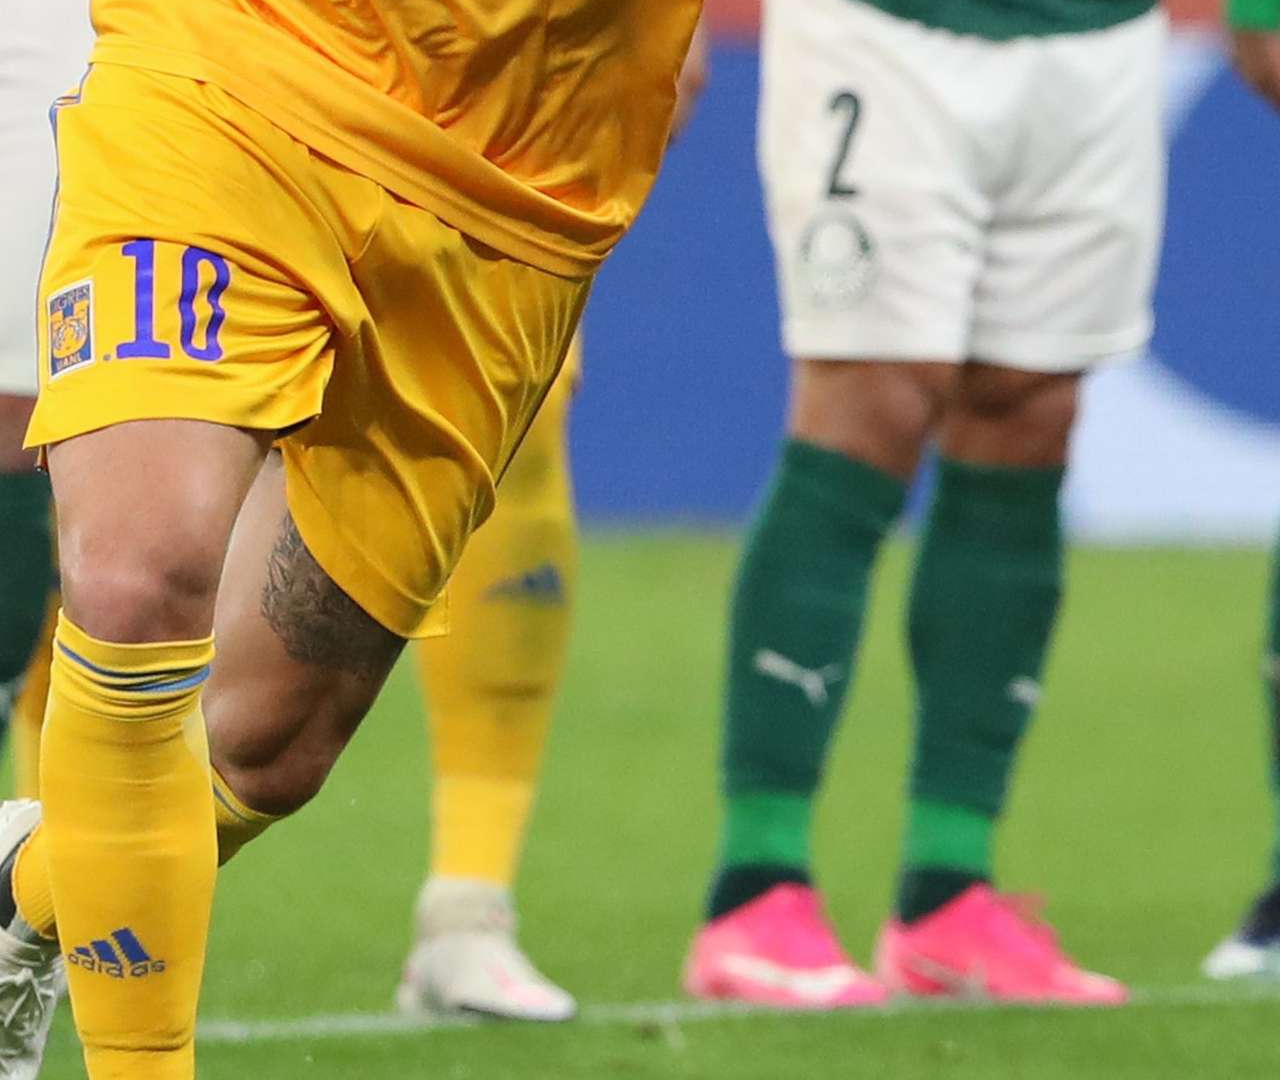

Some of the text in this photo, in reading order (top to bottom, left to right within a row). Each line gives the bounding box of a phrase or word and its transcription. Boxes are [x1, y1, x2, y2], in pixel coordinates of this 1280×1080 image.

[826, 90, 860, 198] 2
[116, 238, 231, 362] 10
[68, 953, 166, 979] adidas
